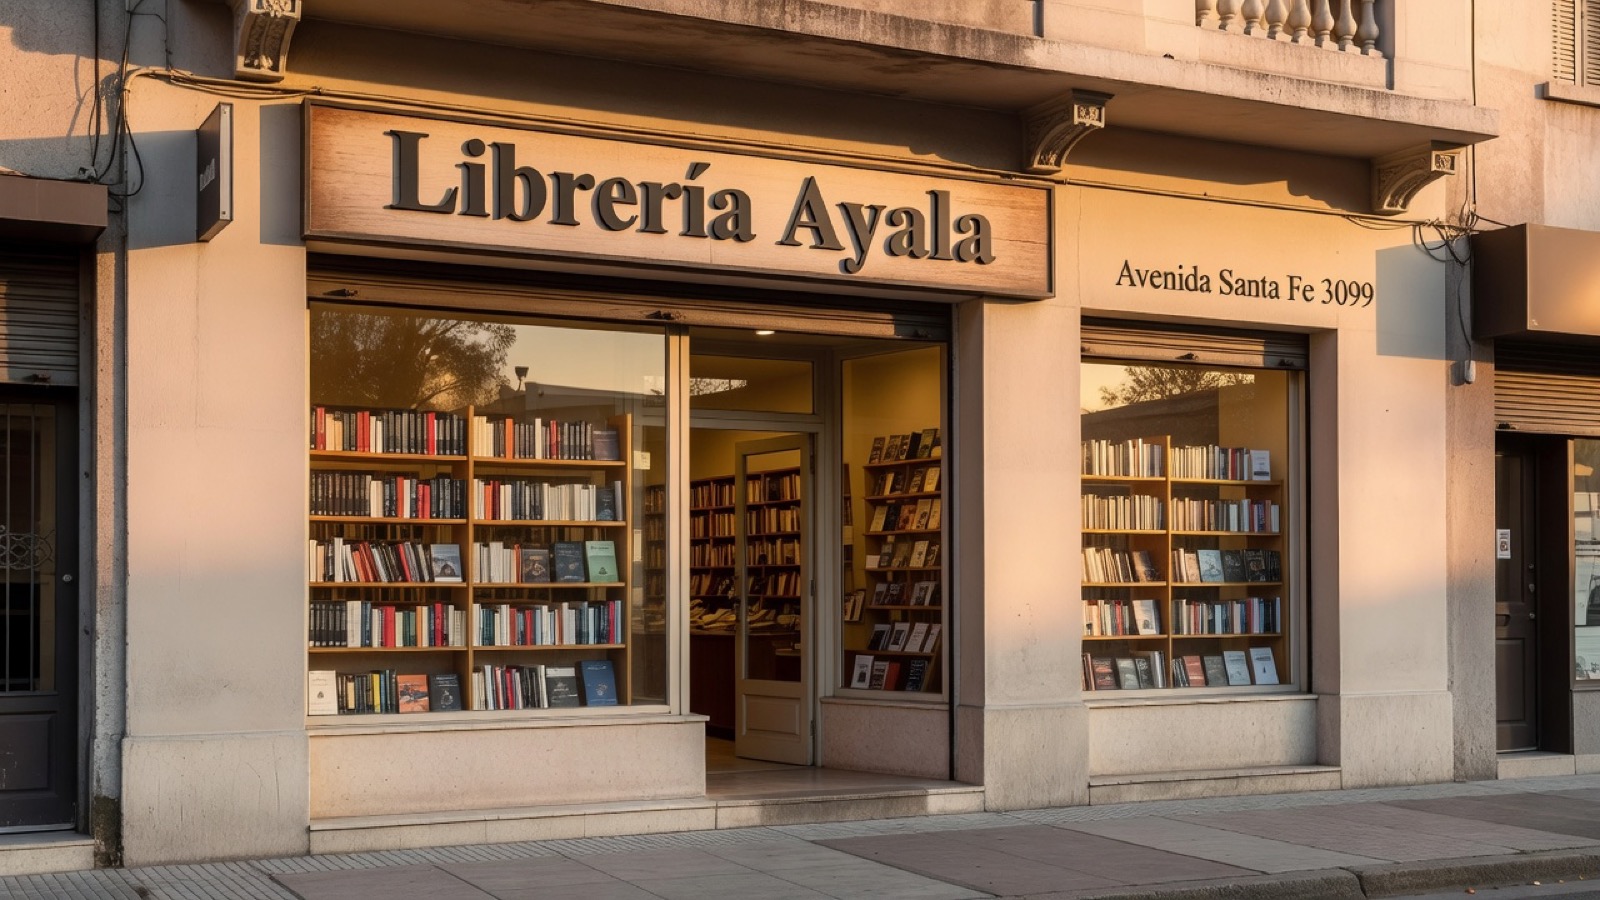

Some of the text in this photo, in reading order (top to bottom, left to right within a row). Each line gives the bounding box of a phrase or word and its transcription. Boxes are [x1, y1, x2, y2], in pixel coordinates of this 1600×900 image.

[383, 130, 996, 274] Librería Ayala
[1116, 260, 1374, 307] Avenida Santa Fe 3099
